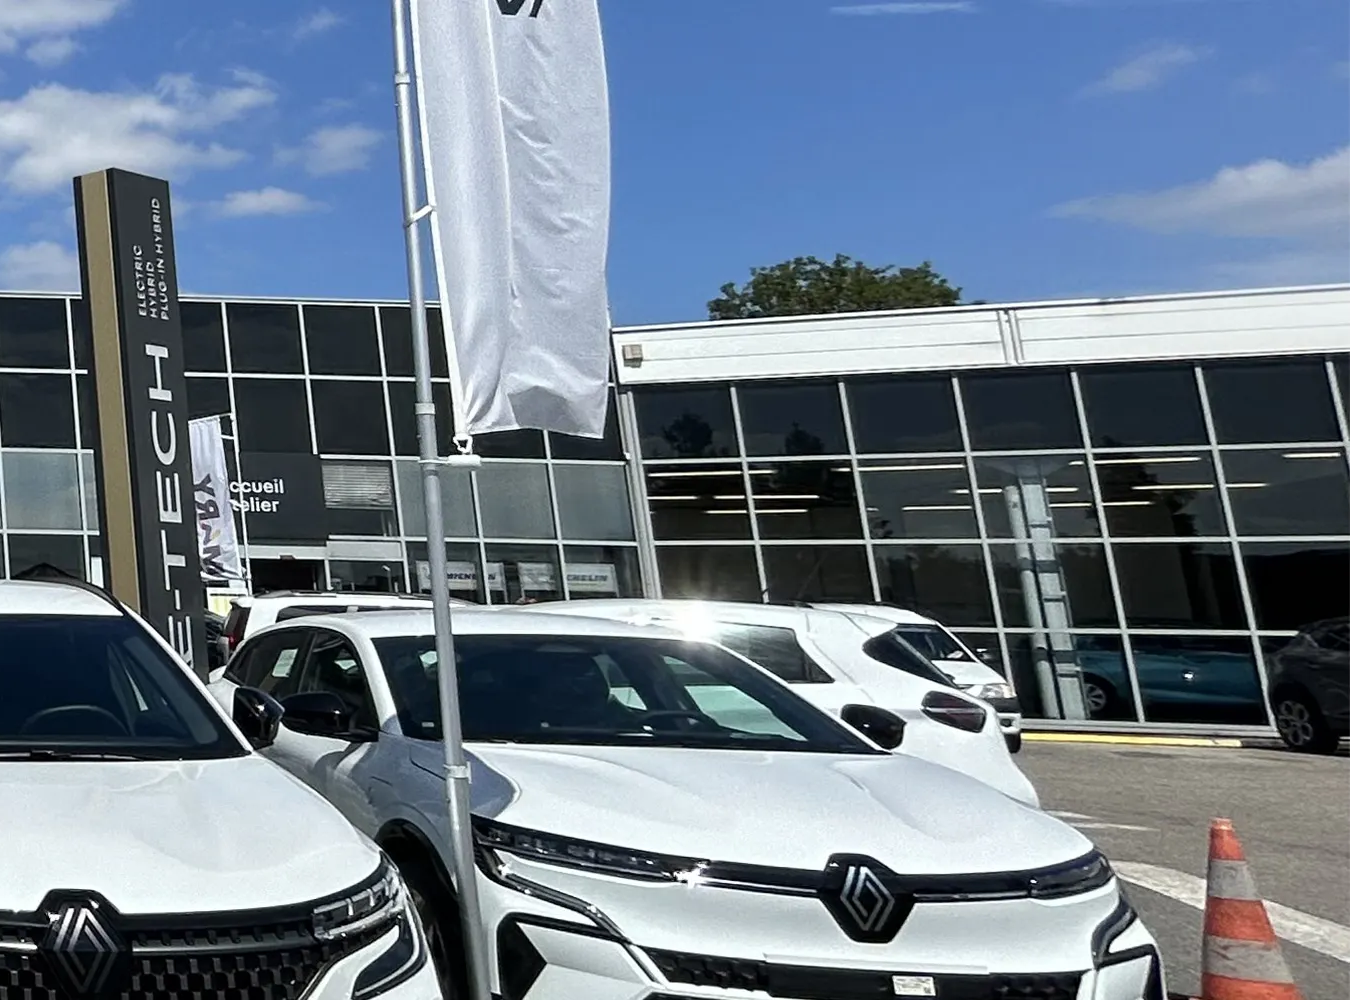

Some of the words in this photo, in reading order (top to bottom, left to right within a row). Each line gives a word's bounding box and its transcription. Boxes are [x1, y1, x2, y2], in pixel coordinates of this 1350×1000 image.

[151, 197, 164, 255] HYBRID
[133, 244, 147, 317] ELECTRIC
[145, 261, 158, 318] HYBRID
[156, 257, 170, 321] PLUG-IN
[145, 343, 195, 670] E-TECH
[229, 478, 284, 494] ccueil
[231, 496, 280, 513] telier
